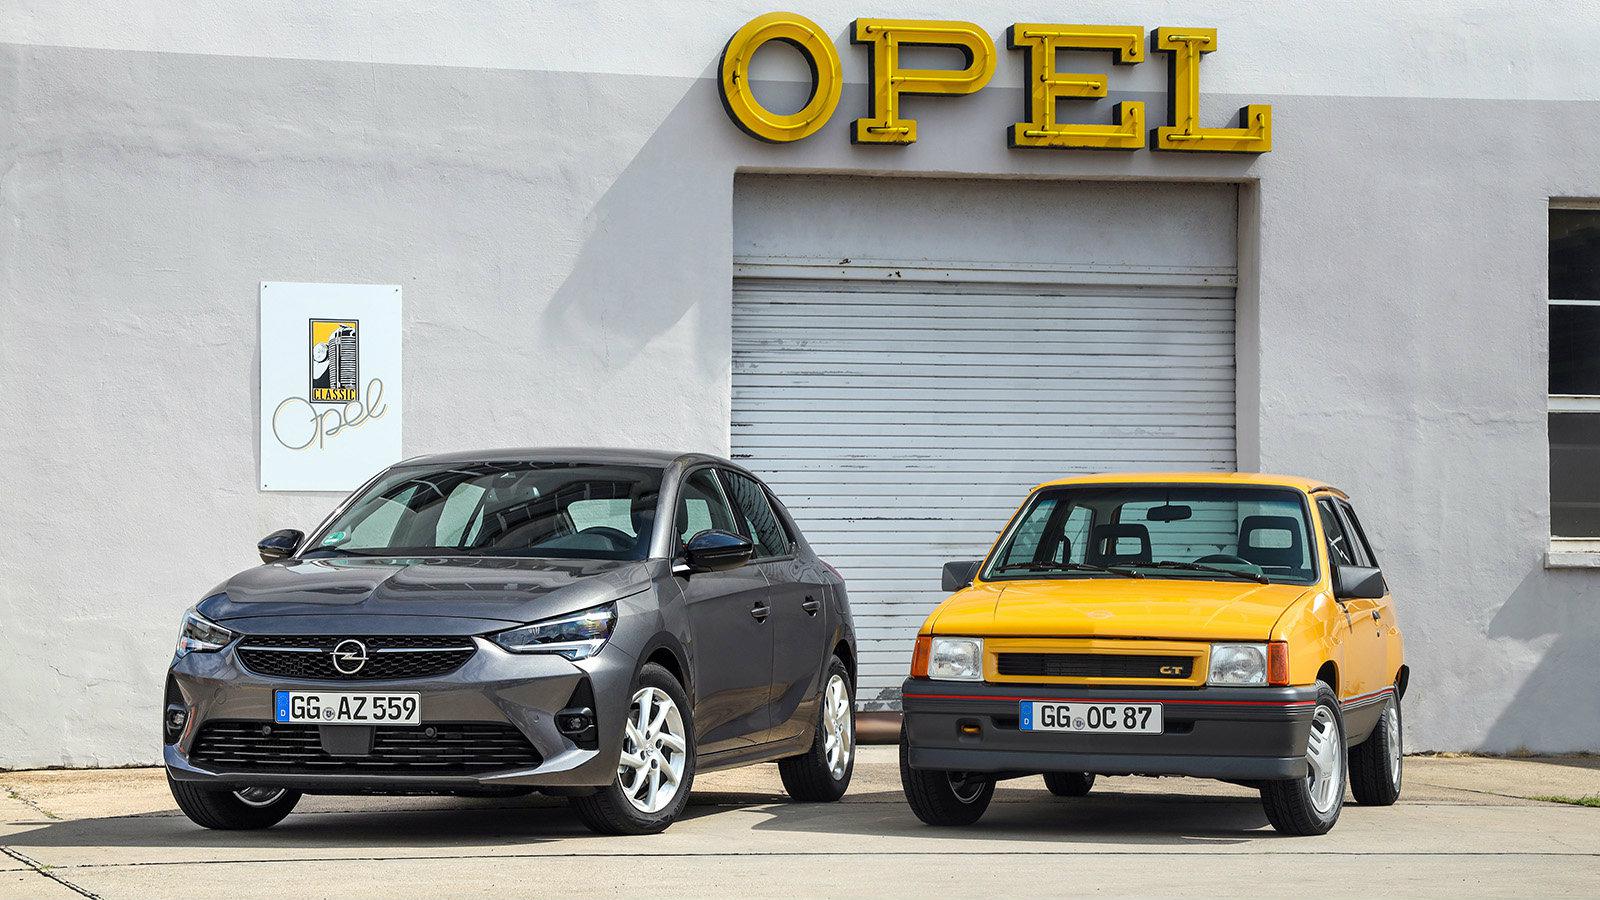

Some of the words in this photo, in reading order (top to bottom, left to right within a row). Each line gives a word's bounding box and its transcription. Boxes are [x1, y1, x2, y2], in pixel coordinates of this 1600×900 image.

[717, 11, 1273, 154] OPEL
[313, 388, 356, 401] CLASSIC
[272, 378, 387, 450] Opel
[1159, 665, 1183, 675] GT
[291, 695, 321, 720] GG
[337, 696, 368, 720] AZ
[373, 696, 417, 721] 559
[1041, 705, 1071, 728] GG
[1087, 706, 1117, 729] OC
[1123, 706, 1153, 730] 87
